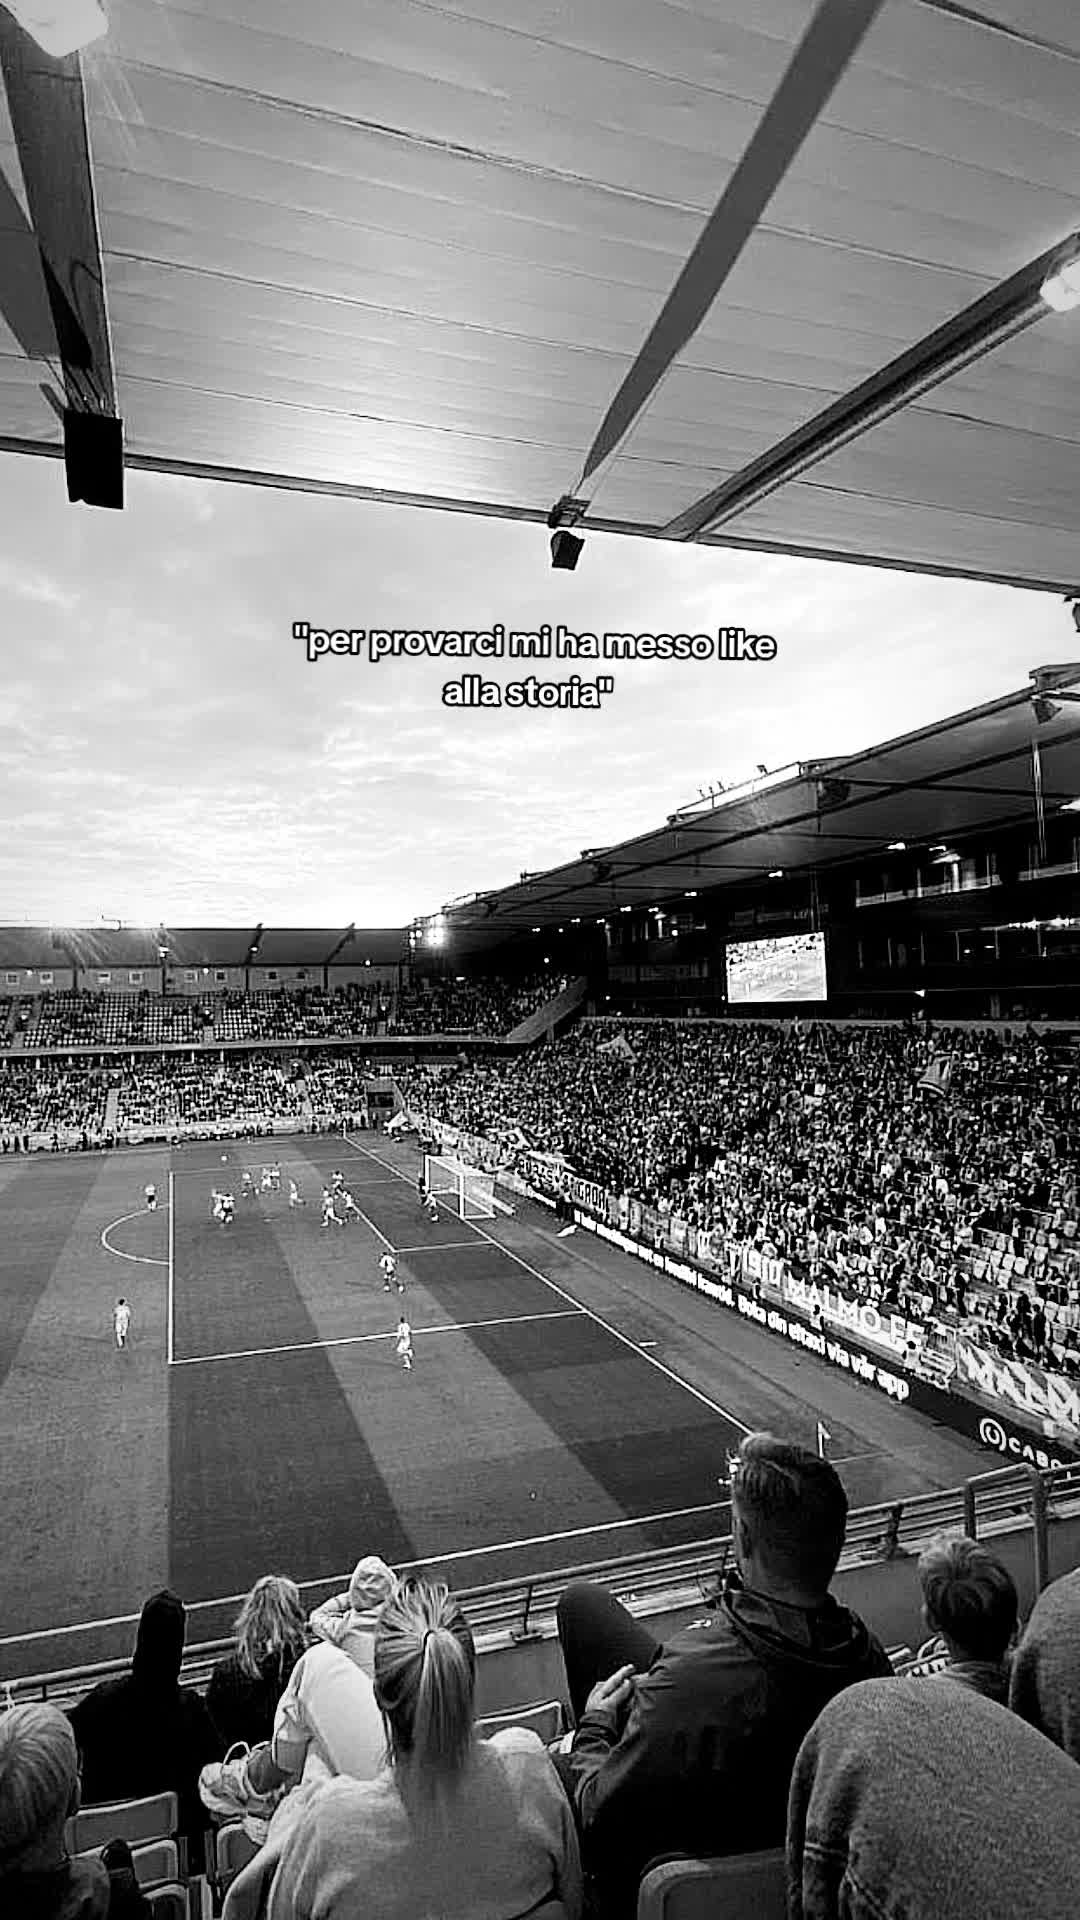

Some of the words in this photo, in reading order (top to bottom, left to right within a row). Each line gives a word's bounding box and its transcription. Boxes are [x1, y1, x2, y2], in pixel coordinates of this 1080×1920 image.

[785, 1269, 882, 1334] MALMÖ
[767, 1311, 788, 1335] din
[826, 1341, 850, 1368] via
[850, 1352, 877, 1381] vår
[876, 1367, 909, 1400] app
